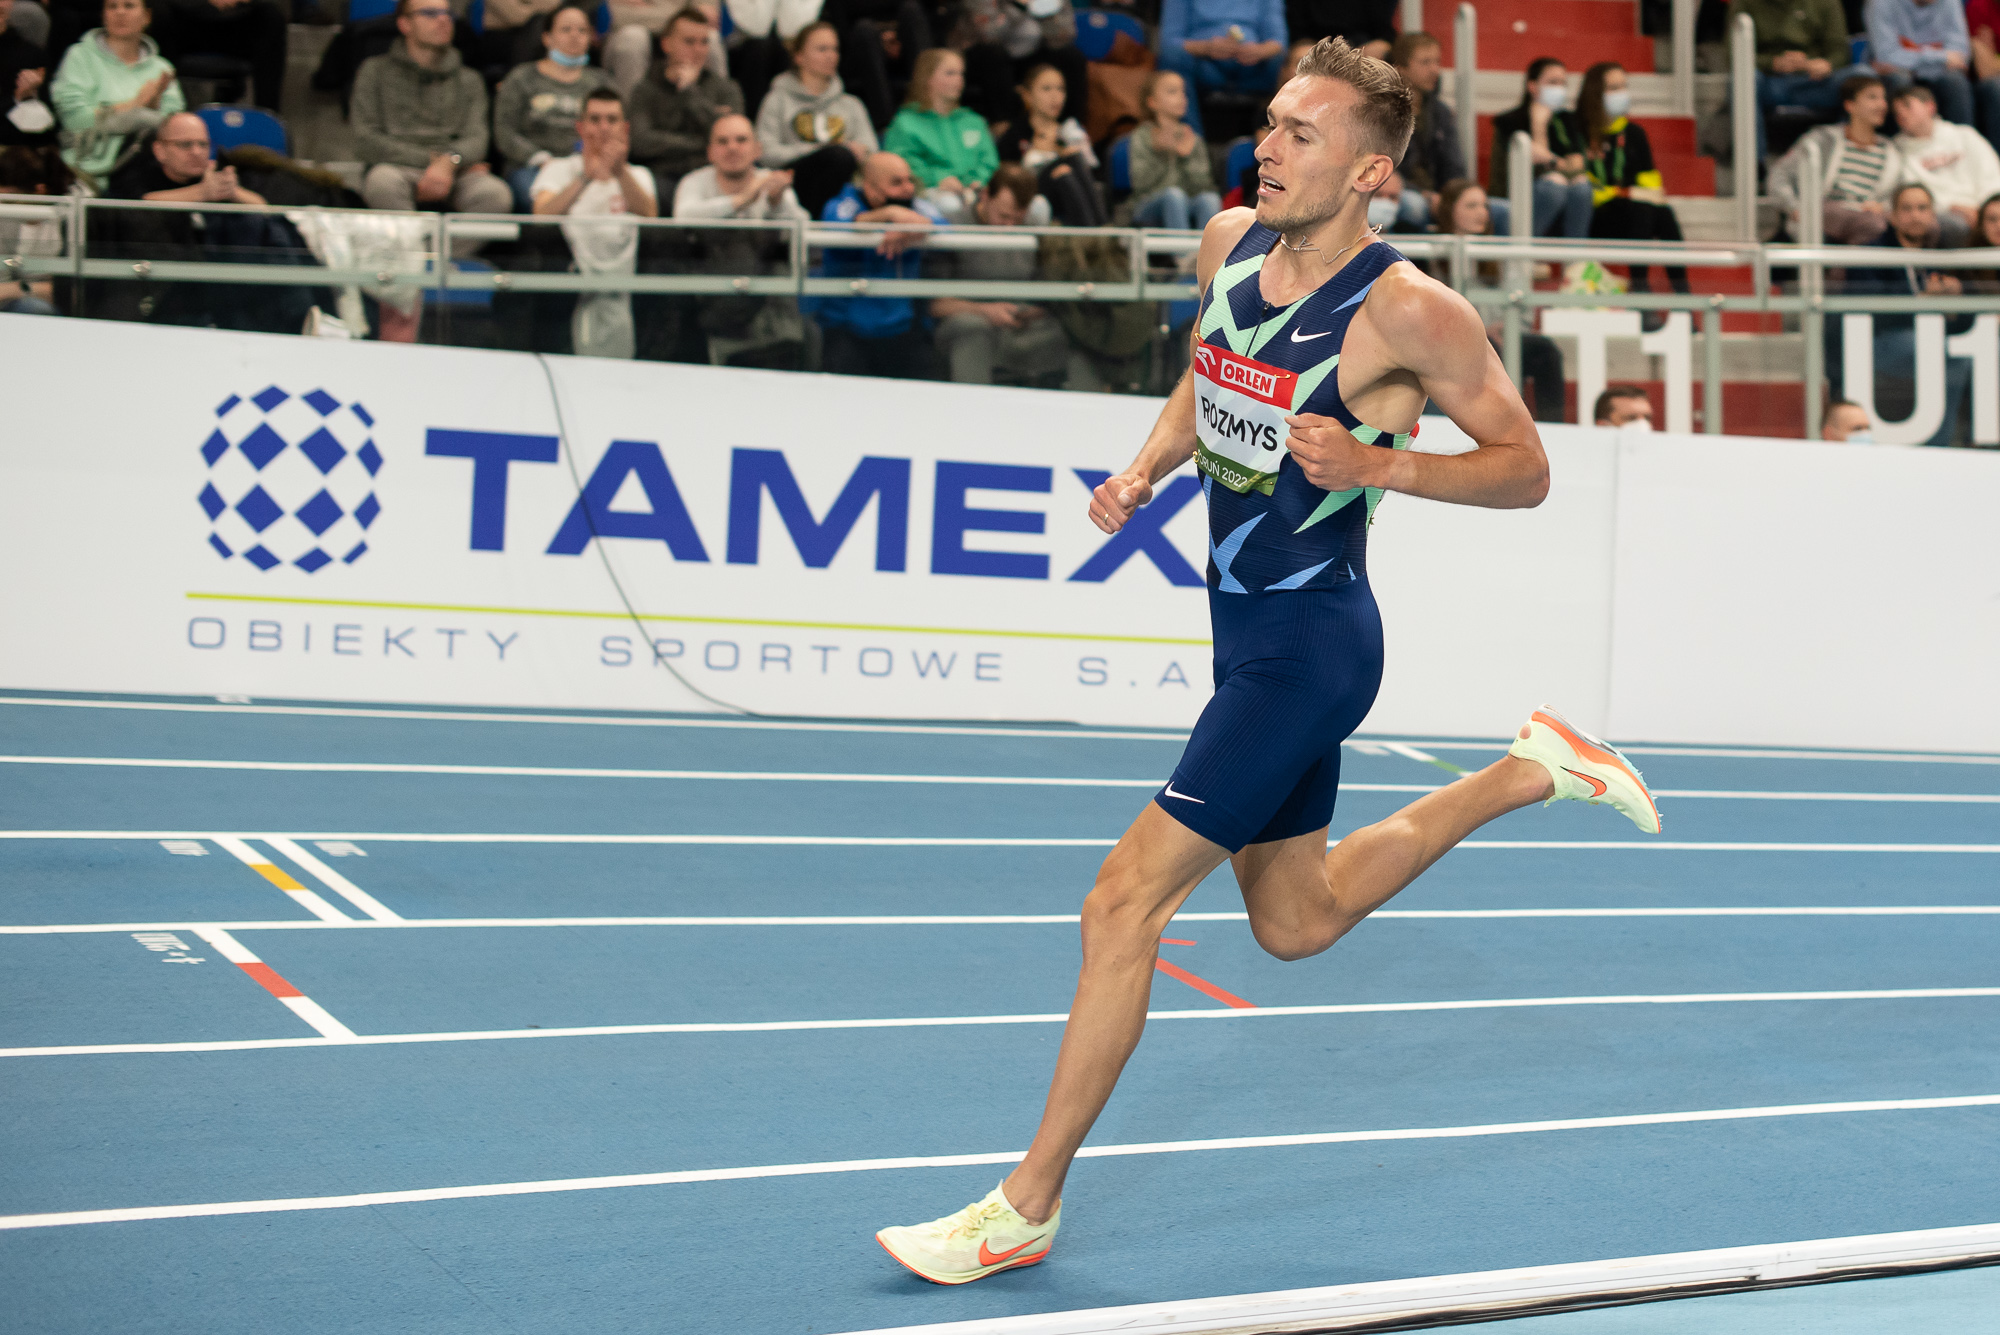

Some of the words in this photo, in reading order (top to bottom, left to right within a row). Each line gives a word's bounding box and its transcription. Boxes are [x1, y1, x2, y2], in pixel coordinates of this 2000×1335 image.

[1223, 362, 1273, 394] ORLEN
[1541, 308, 1692, 433] T1
[1201, 395, 1278, 452] ROZMYS
[1221, 466, 1248, 487] 2022
[424, 427, 1207, 588] TAMEX
[187, 616, 519, 661] OBIEKTY
[600, 635, 1003, 682] SPORTOWE
